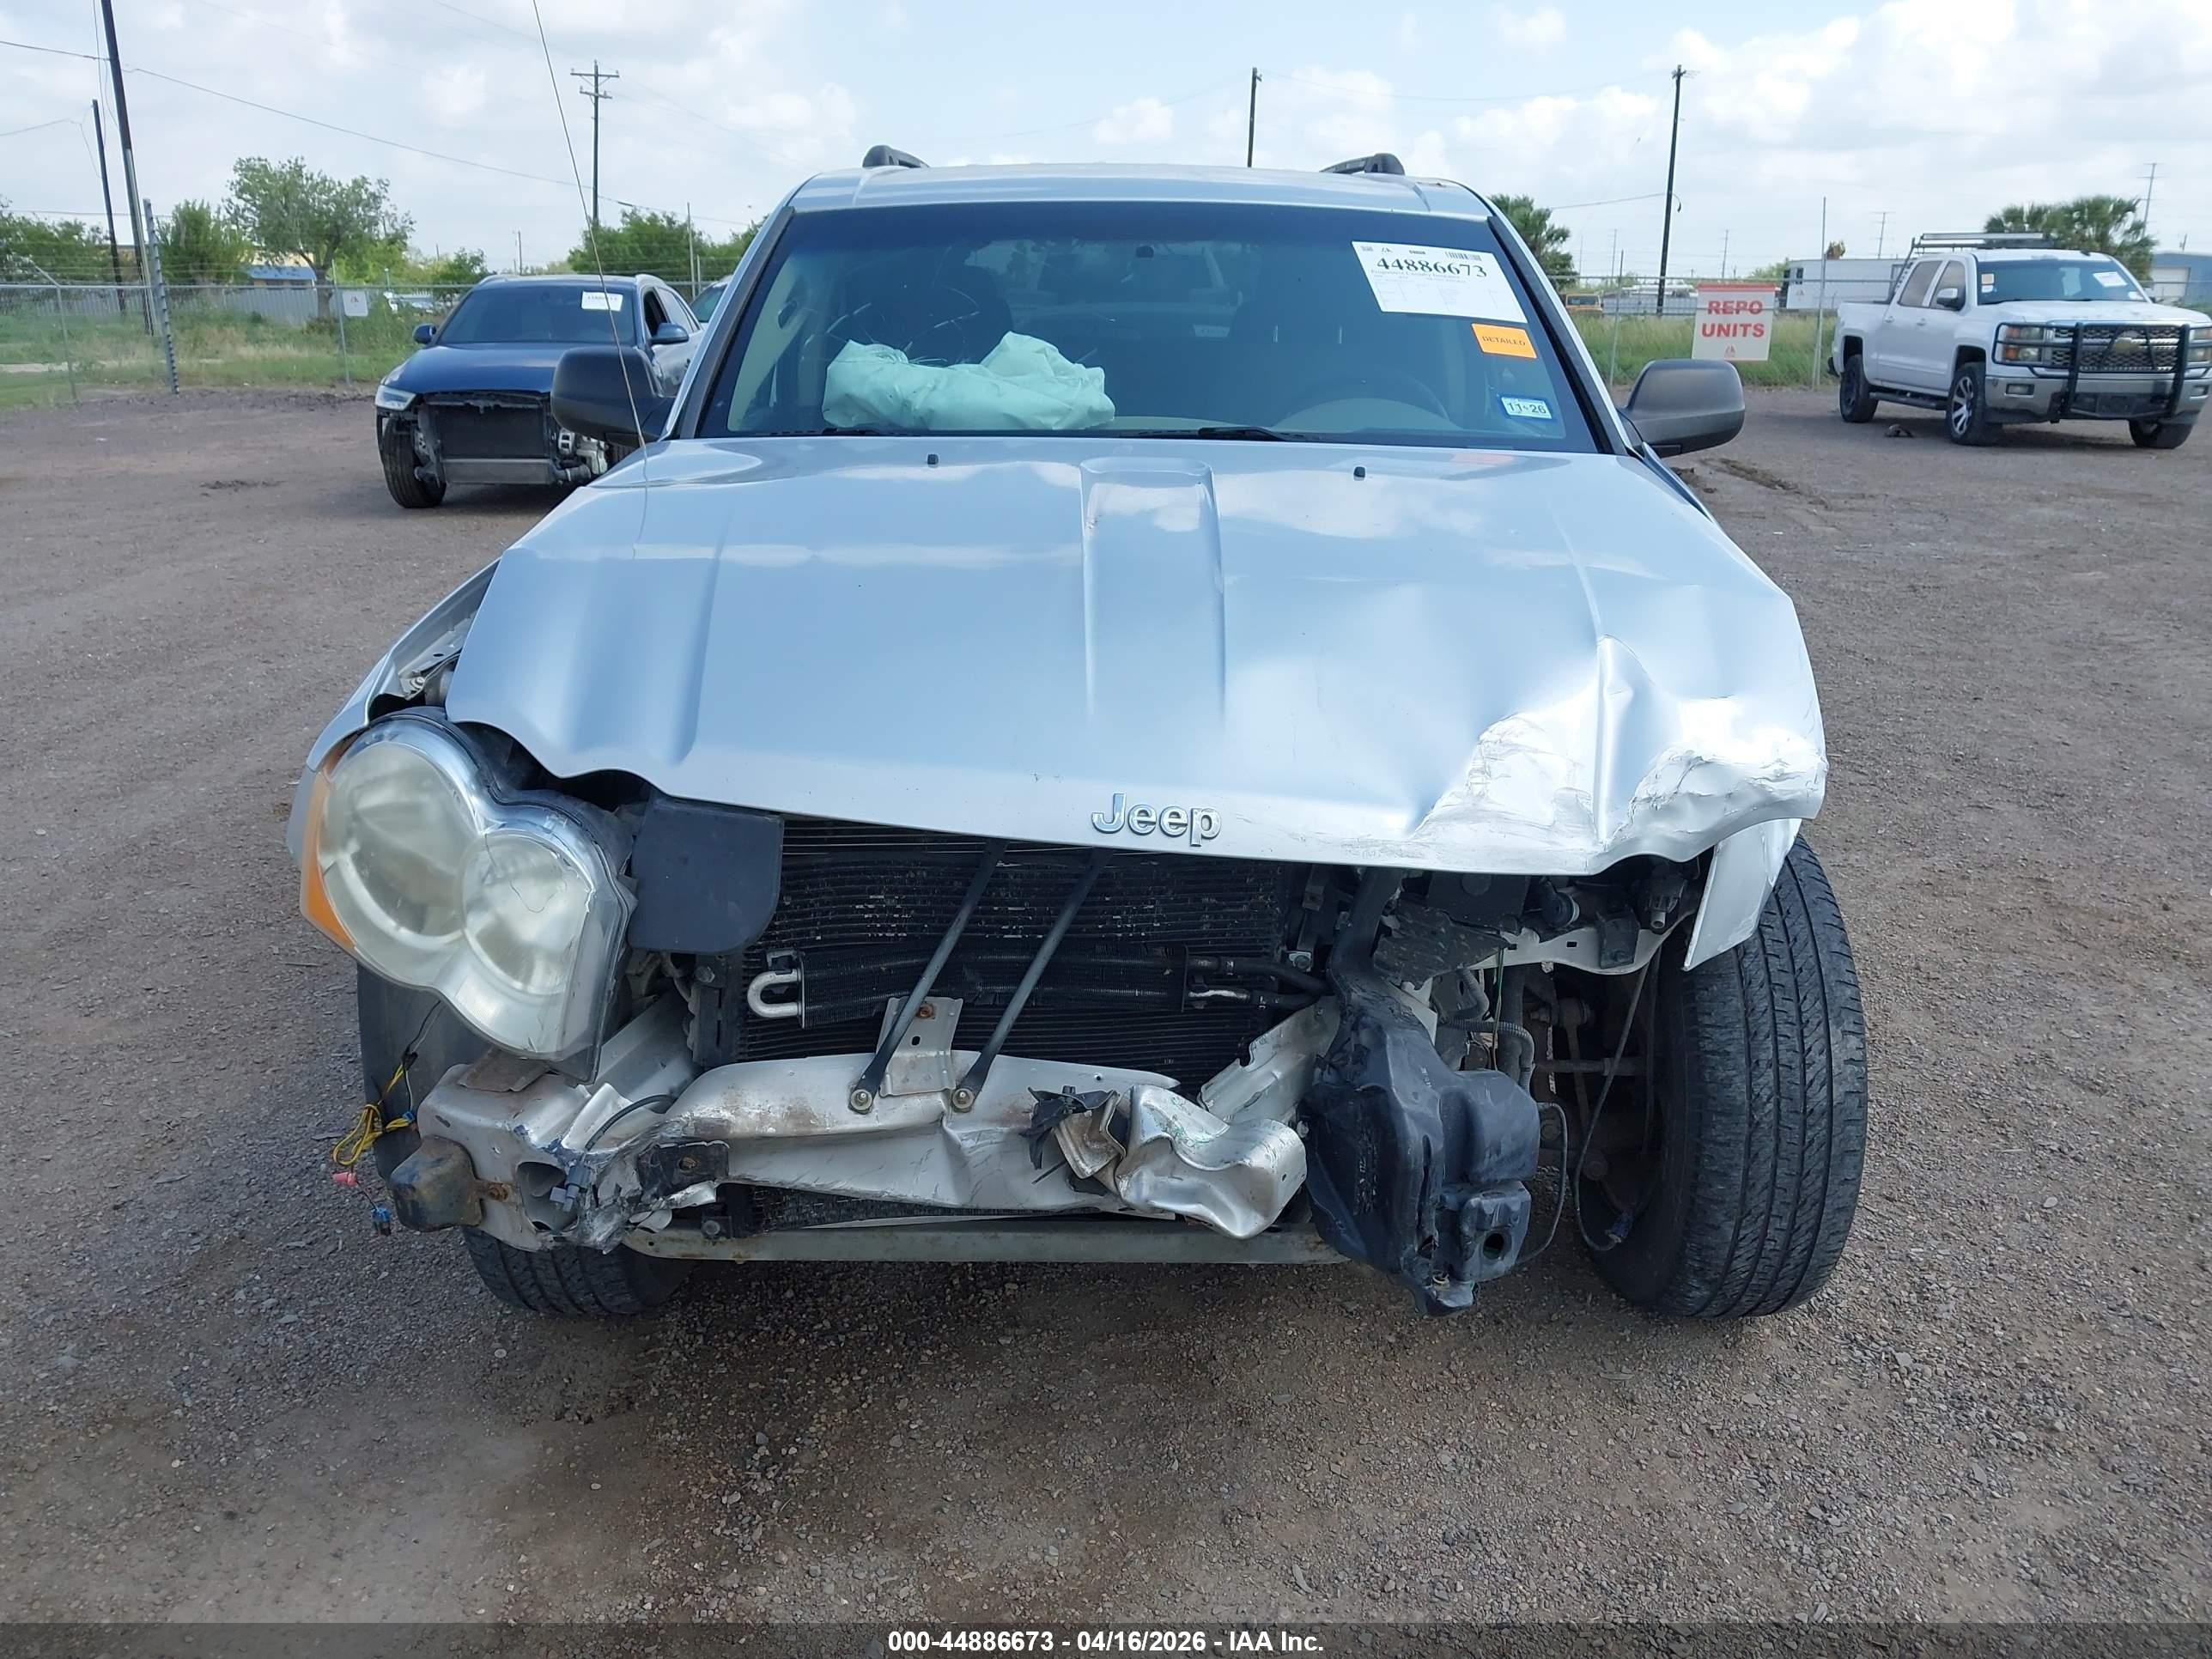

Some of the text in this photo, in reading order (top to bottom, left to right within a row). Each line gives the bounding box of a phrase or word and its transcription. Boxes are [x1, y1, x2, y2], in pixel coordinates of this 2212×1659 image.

[1376, 258, 1487, 277] 44886673
[1707, 301, 1763, 315] REPO
[1701, 323, 1765, 337] UNITS
[1481, 336, 1526, 346] DETAILED
[1091, 792, 1221, 848] Jeep
